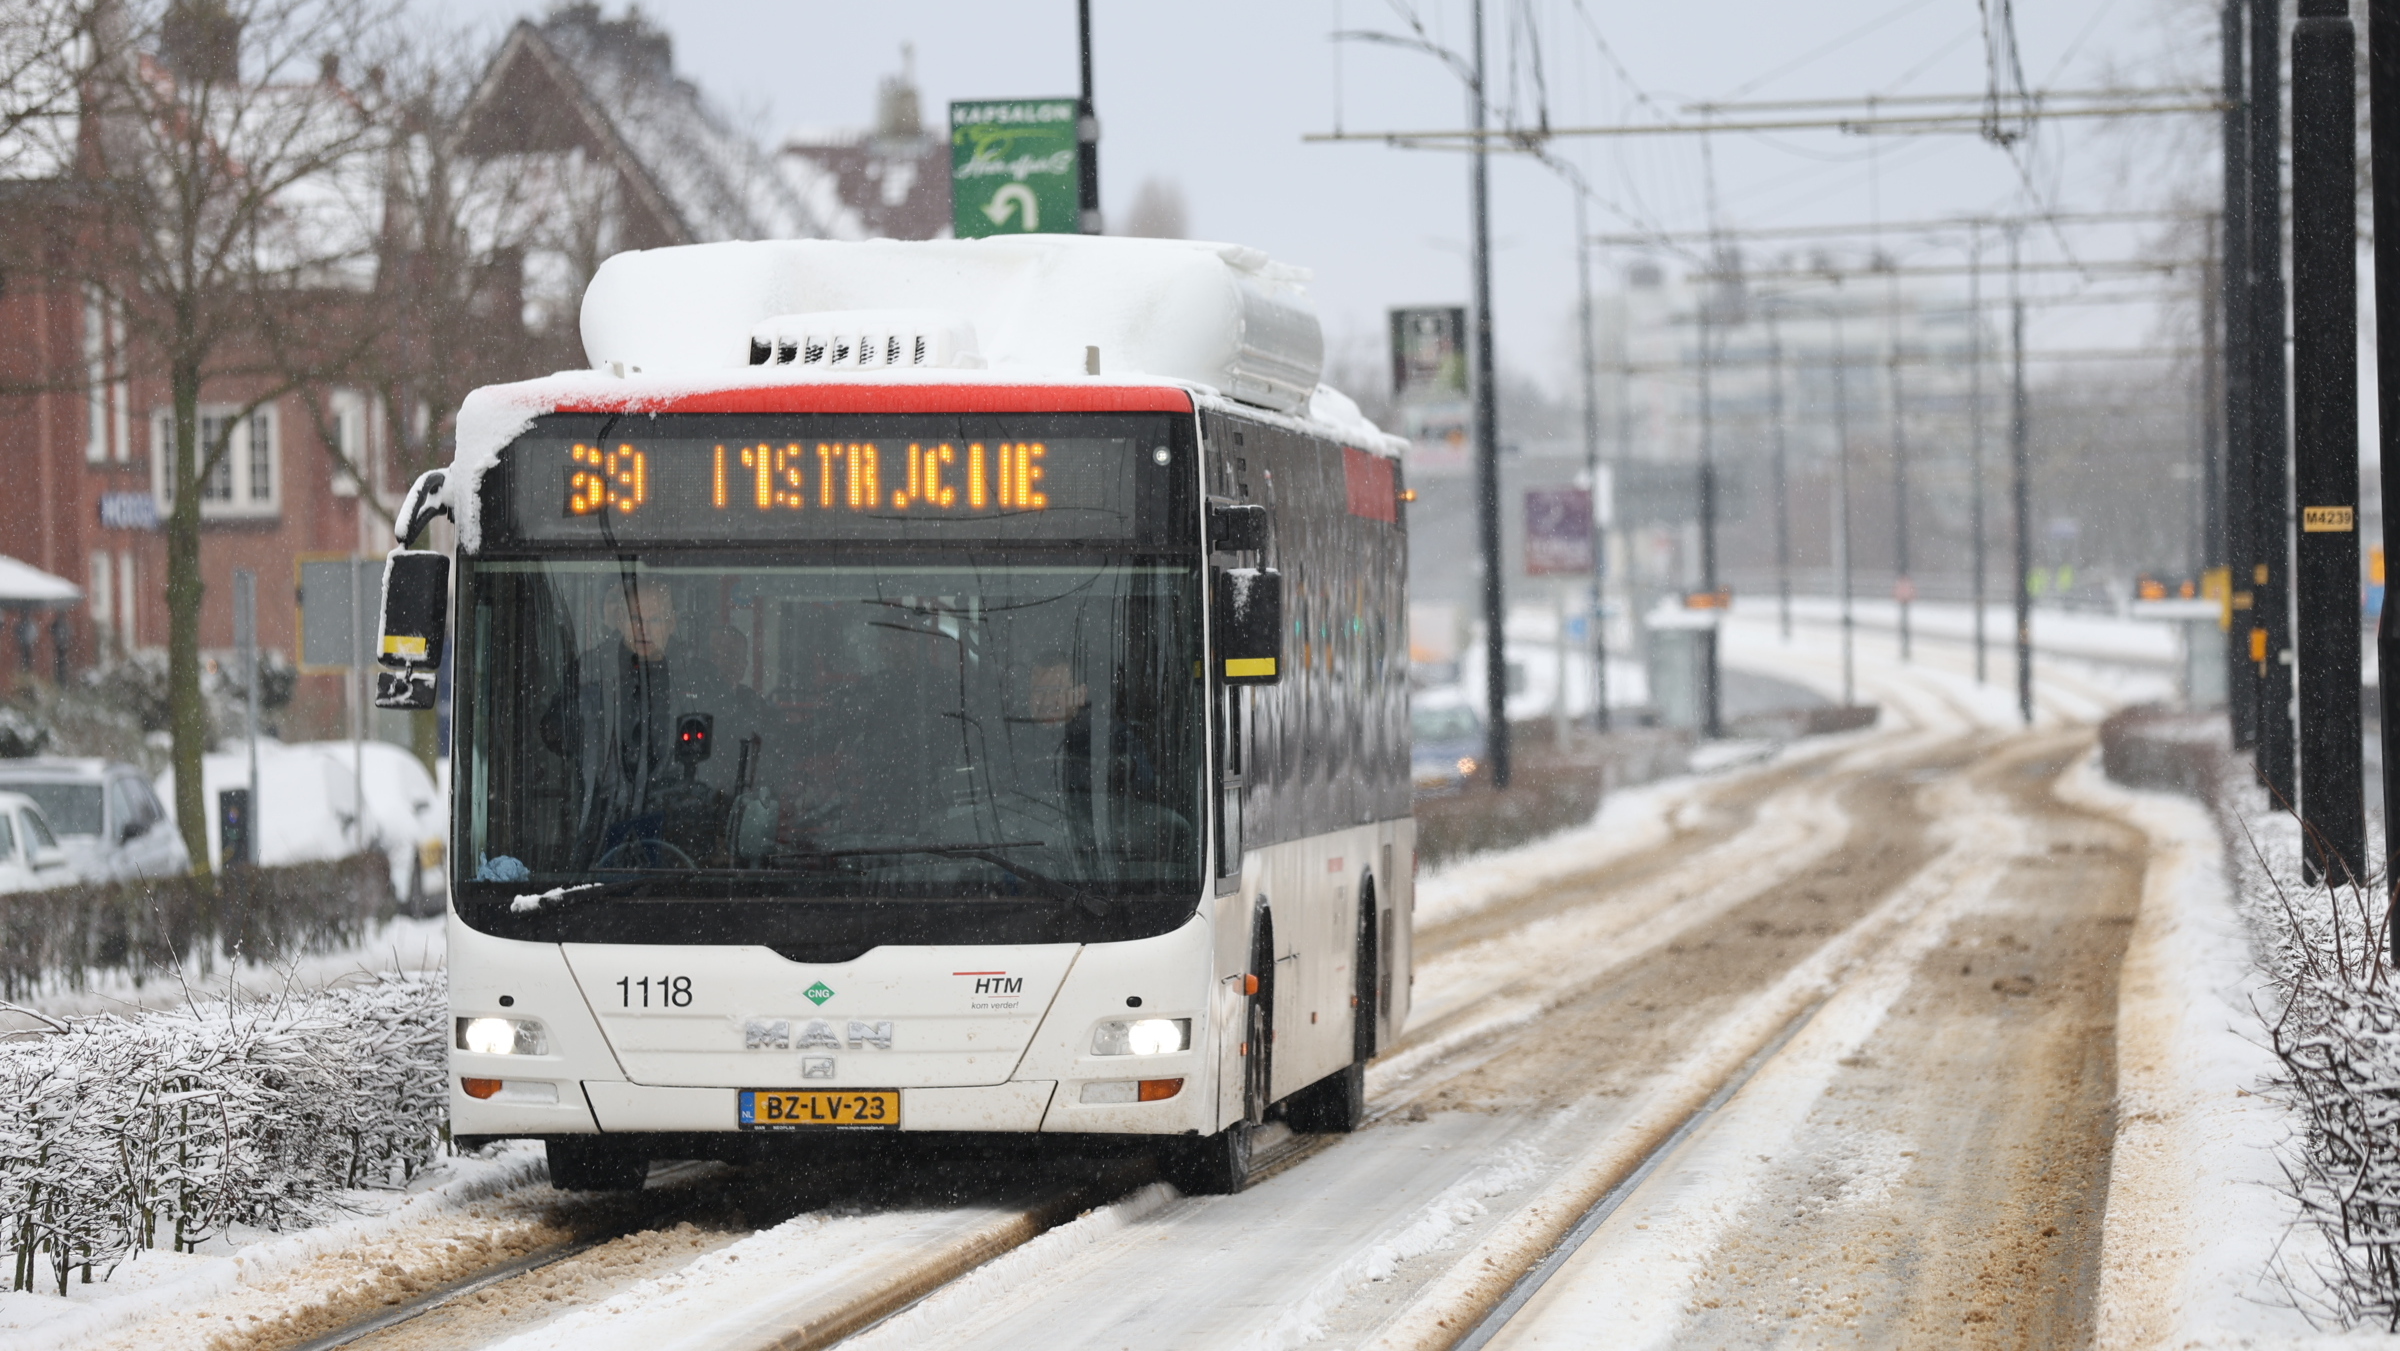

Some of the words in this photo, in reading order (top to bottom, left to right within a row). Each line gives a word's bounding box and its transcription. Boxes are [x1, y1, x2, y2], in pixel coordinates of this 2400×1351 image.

[952, 104, 1072, 124] KAPSALON
[2306, 511, 2352, 525] M4239
[616, 975, 693, 1007] 1118
[807, 989, 831, 998] CNG
[975, 977, 1023, 994] HTM
[971, 1001, 989, 1010] kom
[990, 1001, 1019, 1010] verder!
[746, 1018, 893, 1050] MAN
[742, 1110, 754, 1119] NL
[767, 1096, 885, 1120] BZ-LV-23
